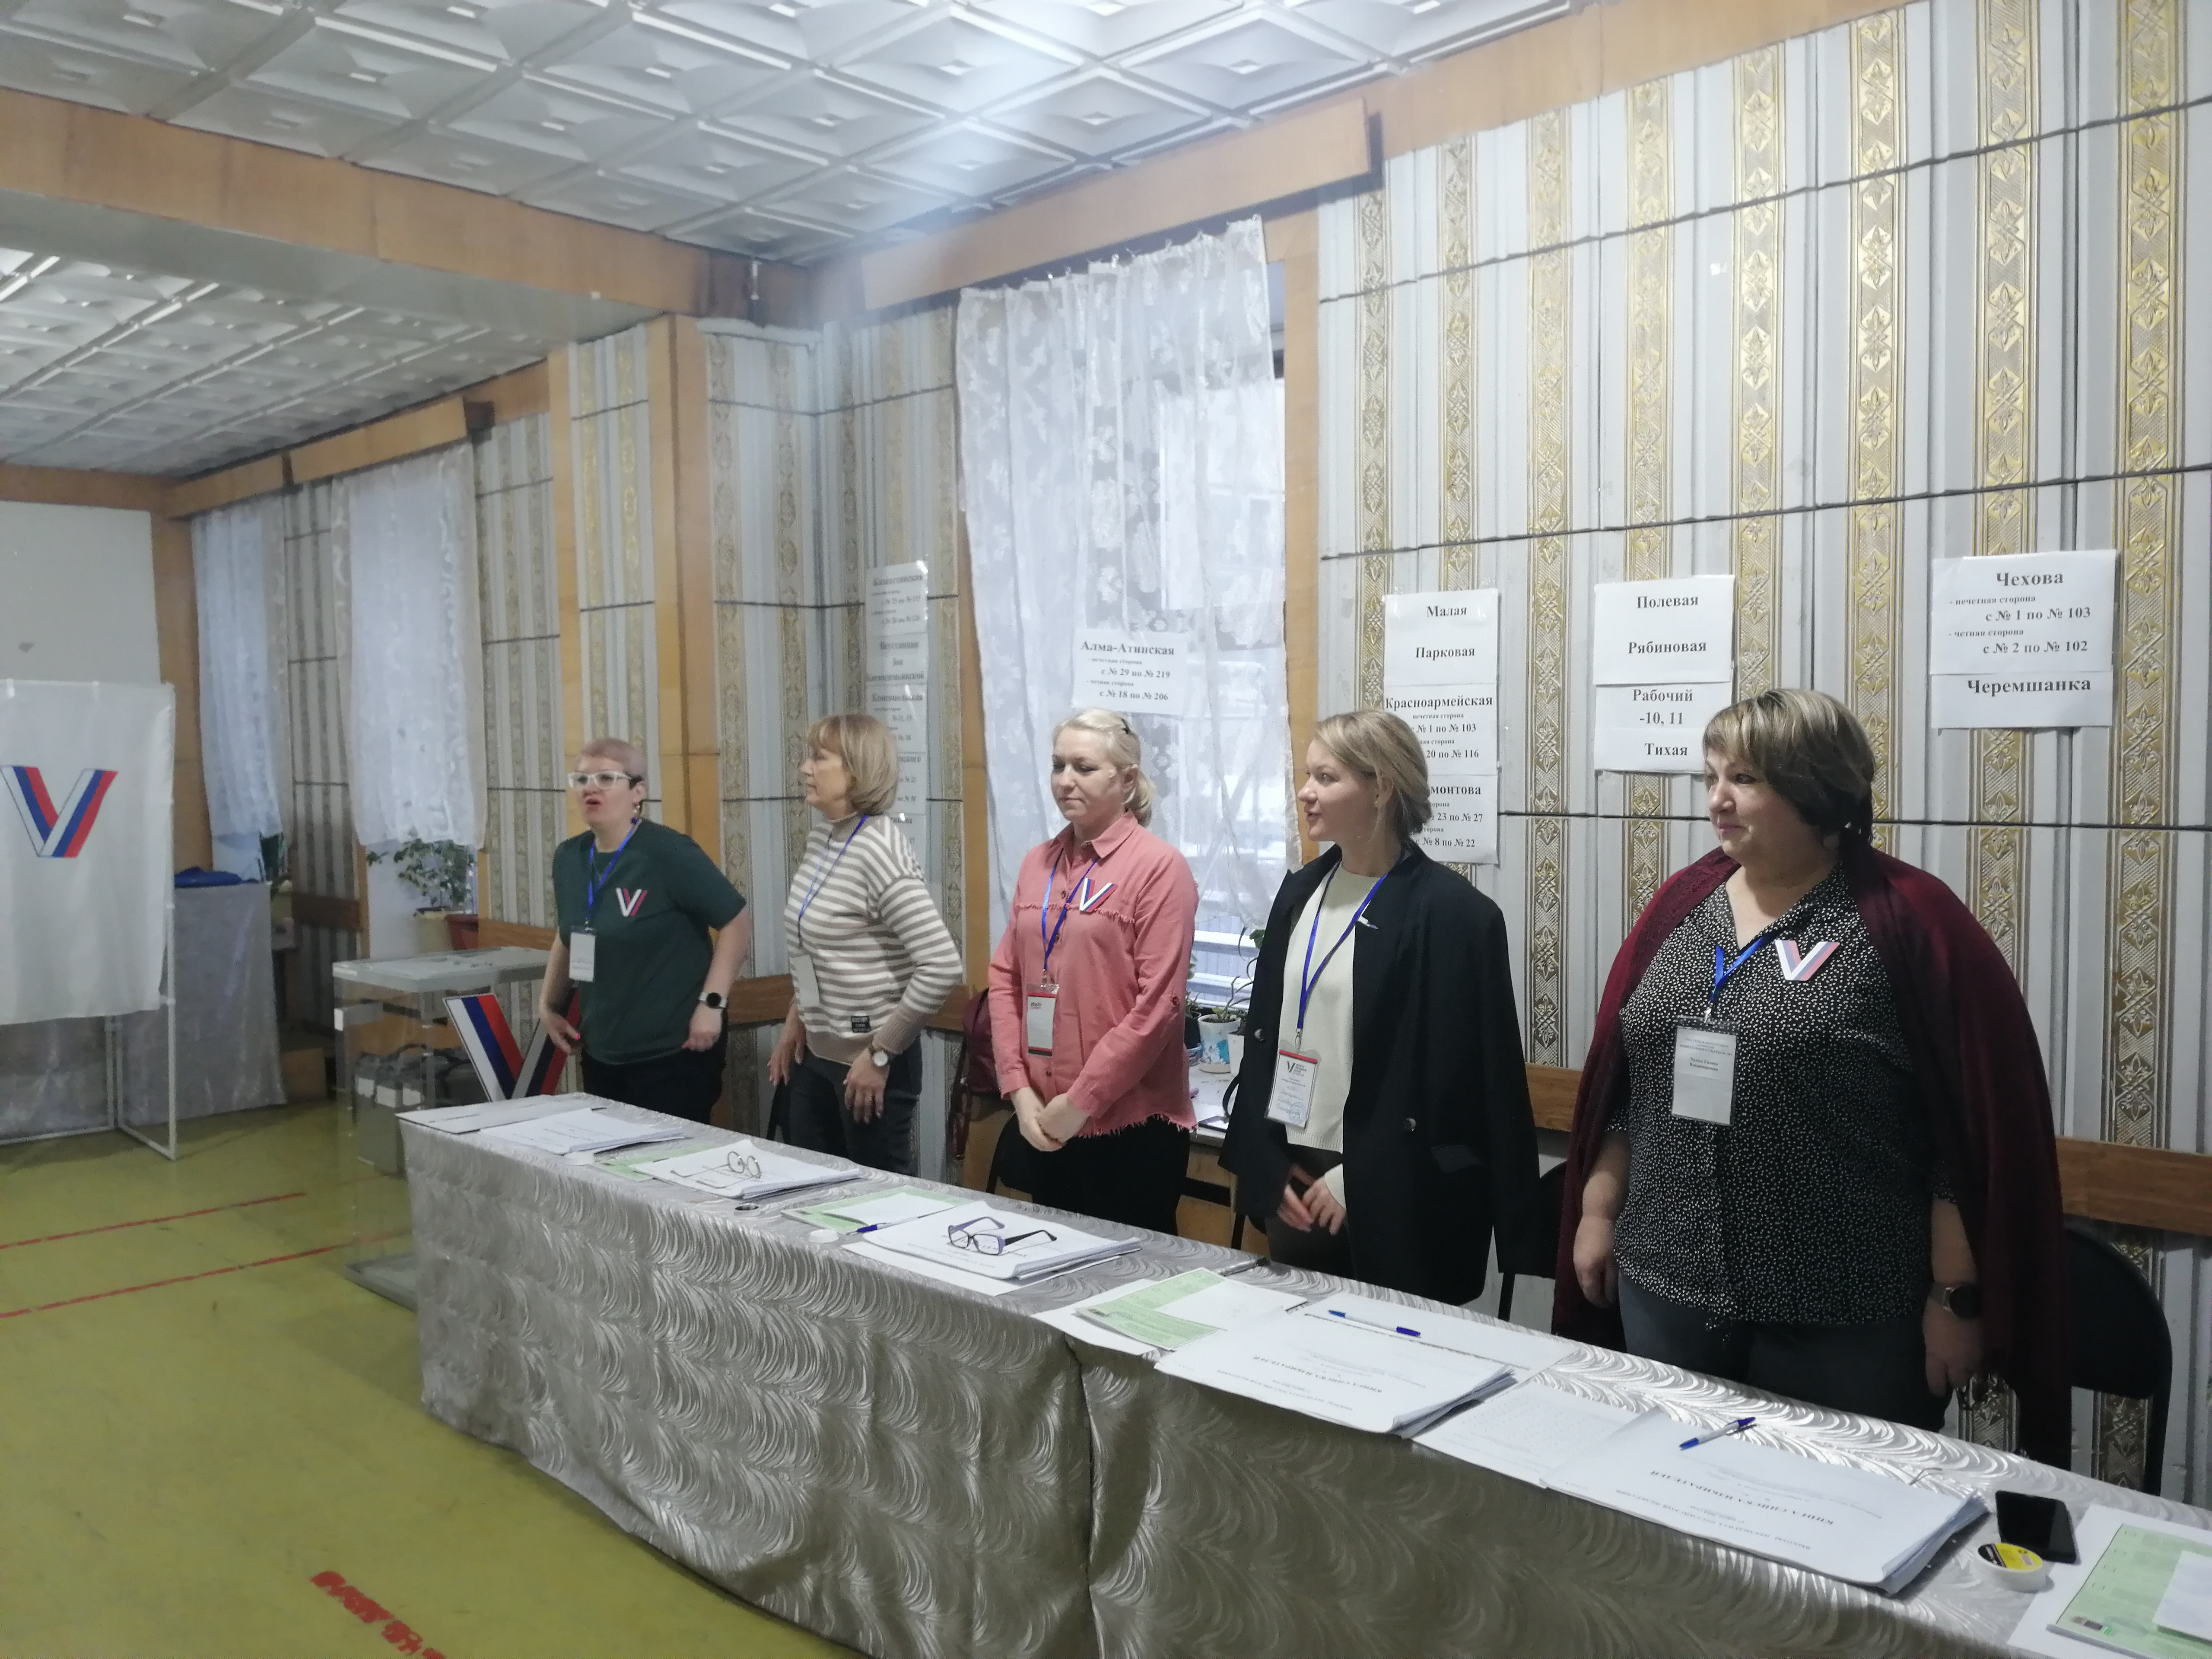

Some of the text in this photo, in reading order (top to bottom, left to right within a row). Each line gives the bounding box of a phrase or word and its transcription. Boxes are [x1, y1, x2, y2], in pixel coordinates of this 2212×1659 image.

[1996, 572, 2064, 586] Чехова
[1637, 595, 1699, 608] Полевая
[1999, 595, 2036, 604] сторона
[1427, 605, 1467, 617] Малая
[1996, 610, 2011, 620] №
[2016, 610, 2021, 620] 1
[2047, 608, 2063, 619] №
[2068, 607, 2091, 618] 103
[1988, 629, 2024, 637] сторона
[1081, 641, 1175, 655] Алма-Атинская
[1416, 646, 1475, 659] Парковая
[1628, 641, 1707, 654] Рябиновая
[1993, 643, 2008, 653] №
[2012, 642, 2019, 653] 2
[2044, 642, 2059, 652] №
[2065, 641, 2088, 652] 102
[1108, 667, 1118, 676] №
[1144, 670, 1154, 678] №
[1967, 679, 2091, 697] Черемшанка
[1106, 690, 1116, 698] №
[1142, 692, 1152, 700] №
[1154, 693, 1169, 701] 206
[1633, 689, 1693, 702] Рабочий
[1386, 695, 1493, 710] Красноармейская
[1669, 712, 1683, 725] 11
[1417, 724, 1426, 733] №
[1429, 724, 1433, 732] 1
[1449, 724, 1459, 732] №
[1462, 723, 1477, 732] 103
[1426, 750, 1435, 758] 20
[1451, 750, 1461, 758] №
[1465, 749, 1479, 758] 116
[1644, 743, 1688, 756] Тихая
[1430, 786, 1481, 795] монтова
[1437, 812, 1446, 821] 23
[1462, 813, 1471, 821] №
[1474, 814, 1483, 822] 27
[1422, 837, 1432, 845] №
[1454, 839, 1463, 847] №
[1466, 839, 1475, 847] 22
